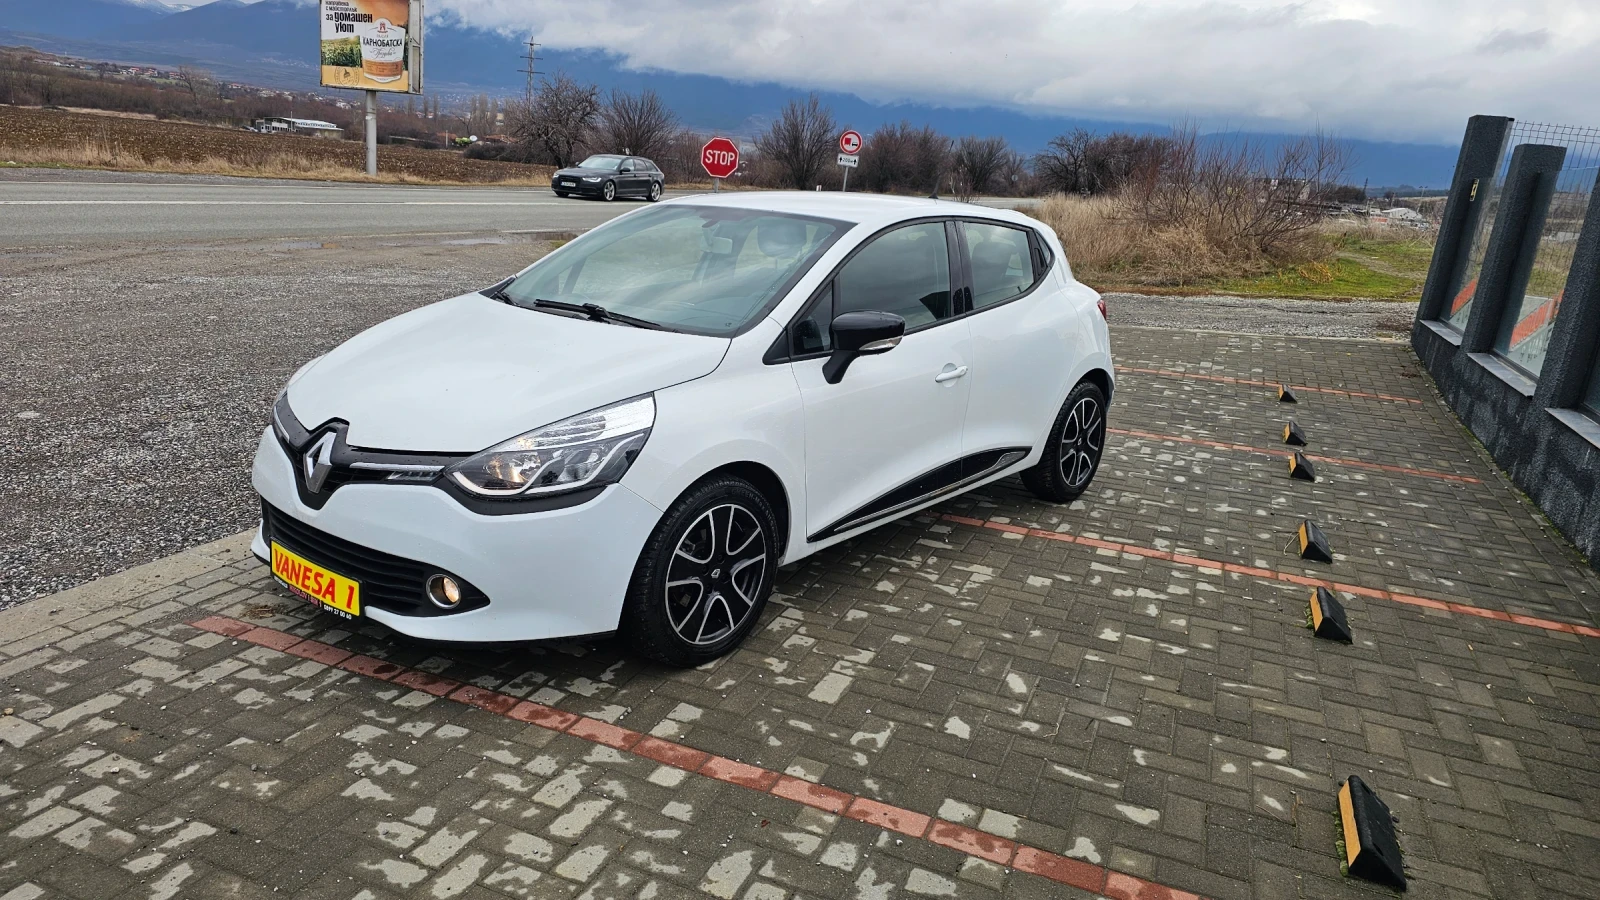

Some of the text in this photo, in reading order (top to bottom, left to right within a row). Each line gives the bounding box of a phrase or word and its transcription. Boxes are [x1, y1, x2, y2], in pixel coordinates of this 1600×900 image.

[334, 12, 373, 23] домашен
[335, 22, 354, 33] уют
[705, 149, 735, 166] STOP
[274, 548, 355, 610] VANESA 1
